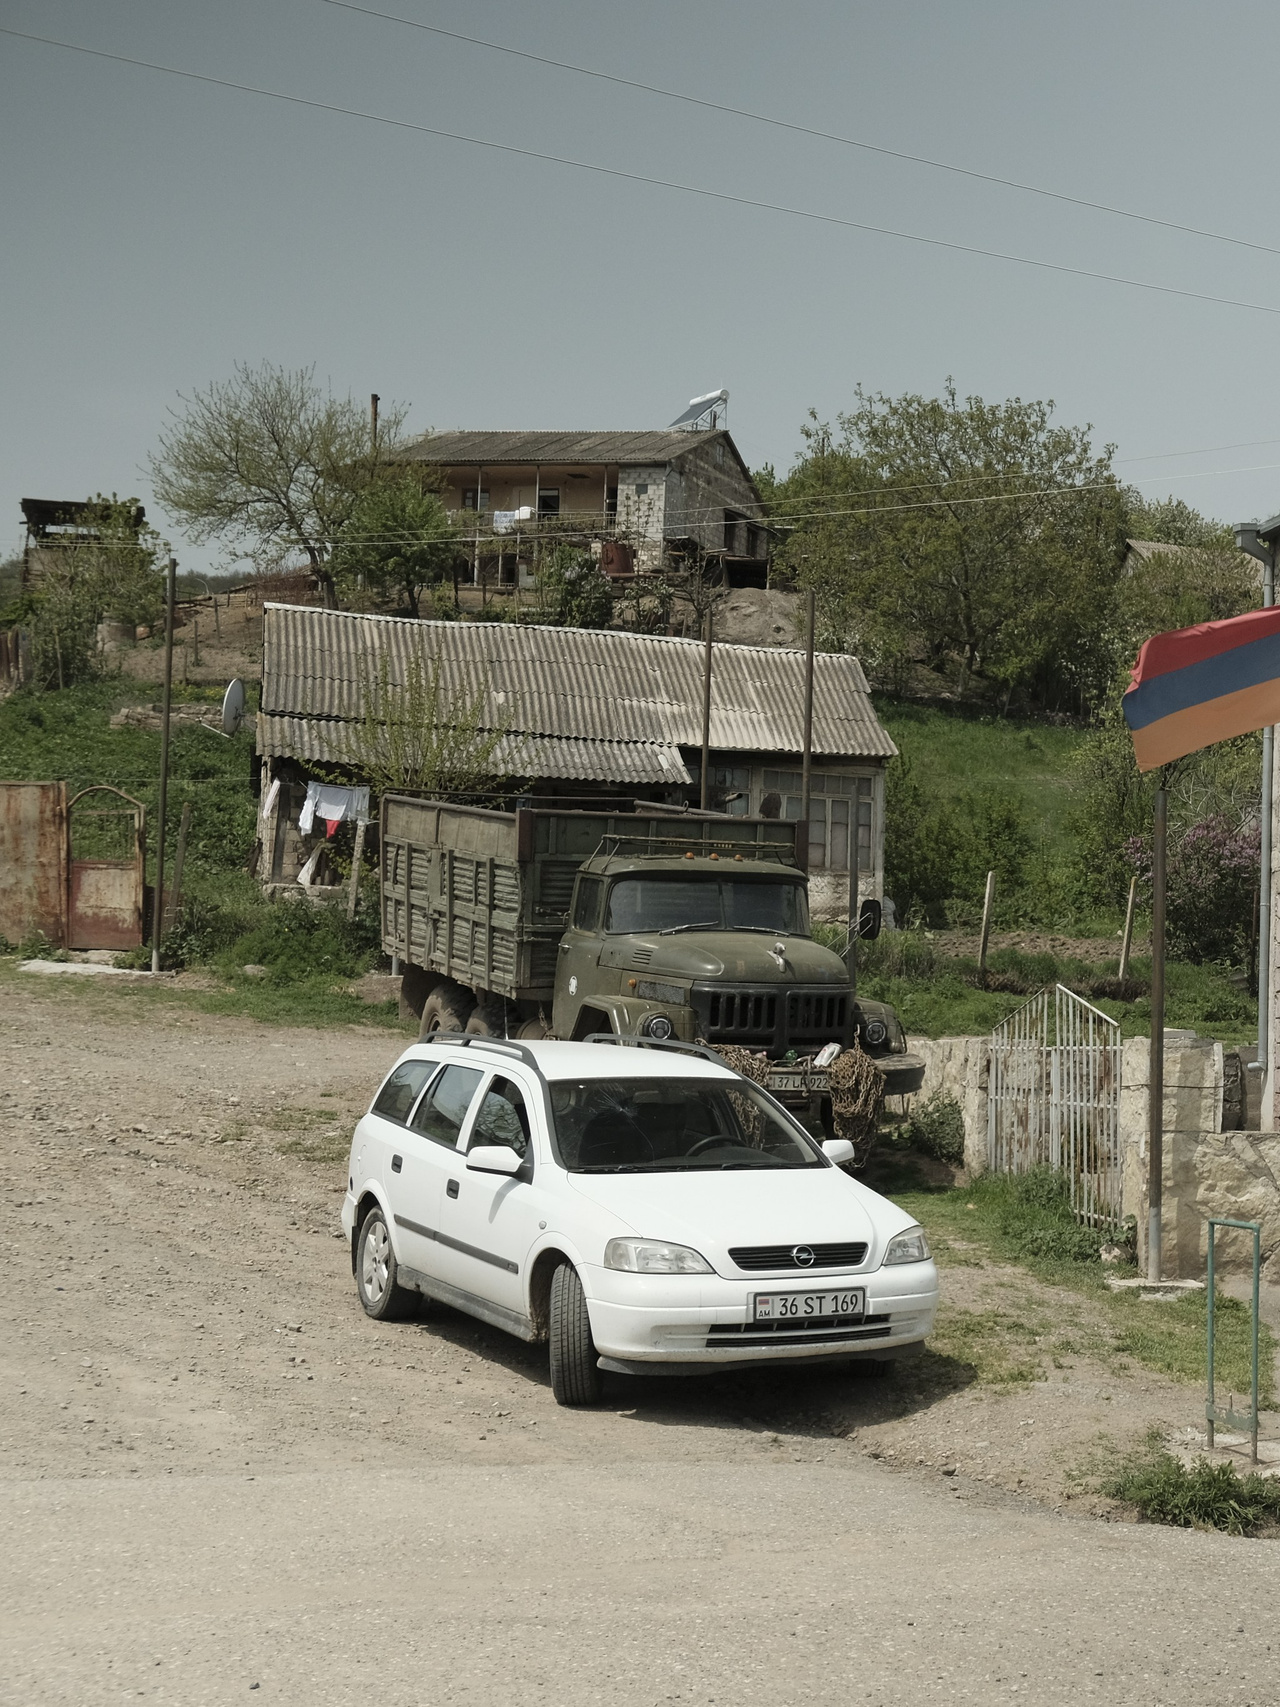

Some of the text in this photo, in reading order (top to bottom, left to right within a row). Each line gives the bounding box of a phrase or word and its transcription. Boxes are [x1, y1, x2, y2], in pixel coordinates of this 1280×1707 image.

[777, 1076, 789, 1088] 37
[810, 1077, 828, 1089] 922
[779, 1294, 858, 1316] 36 ST 169
[758, 1309, 770, 1318] AM
